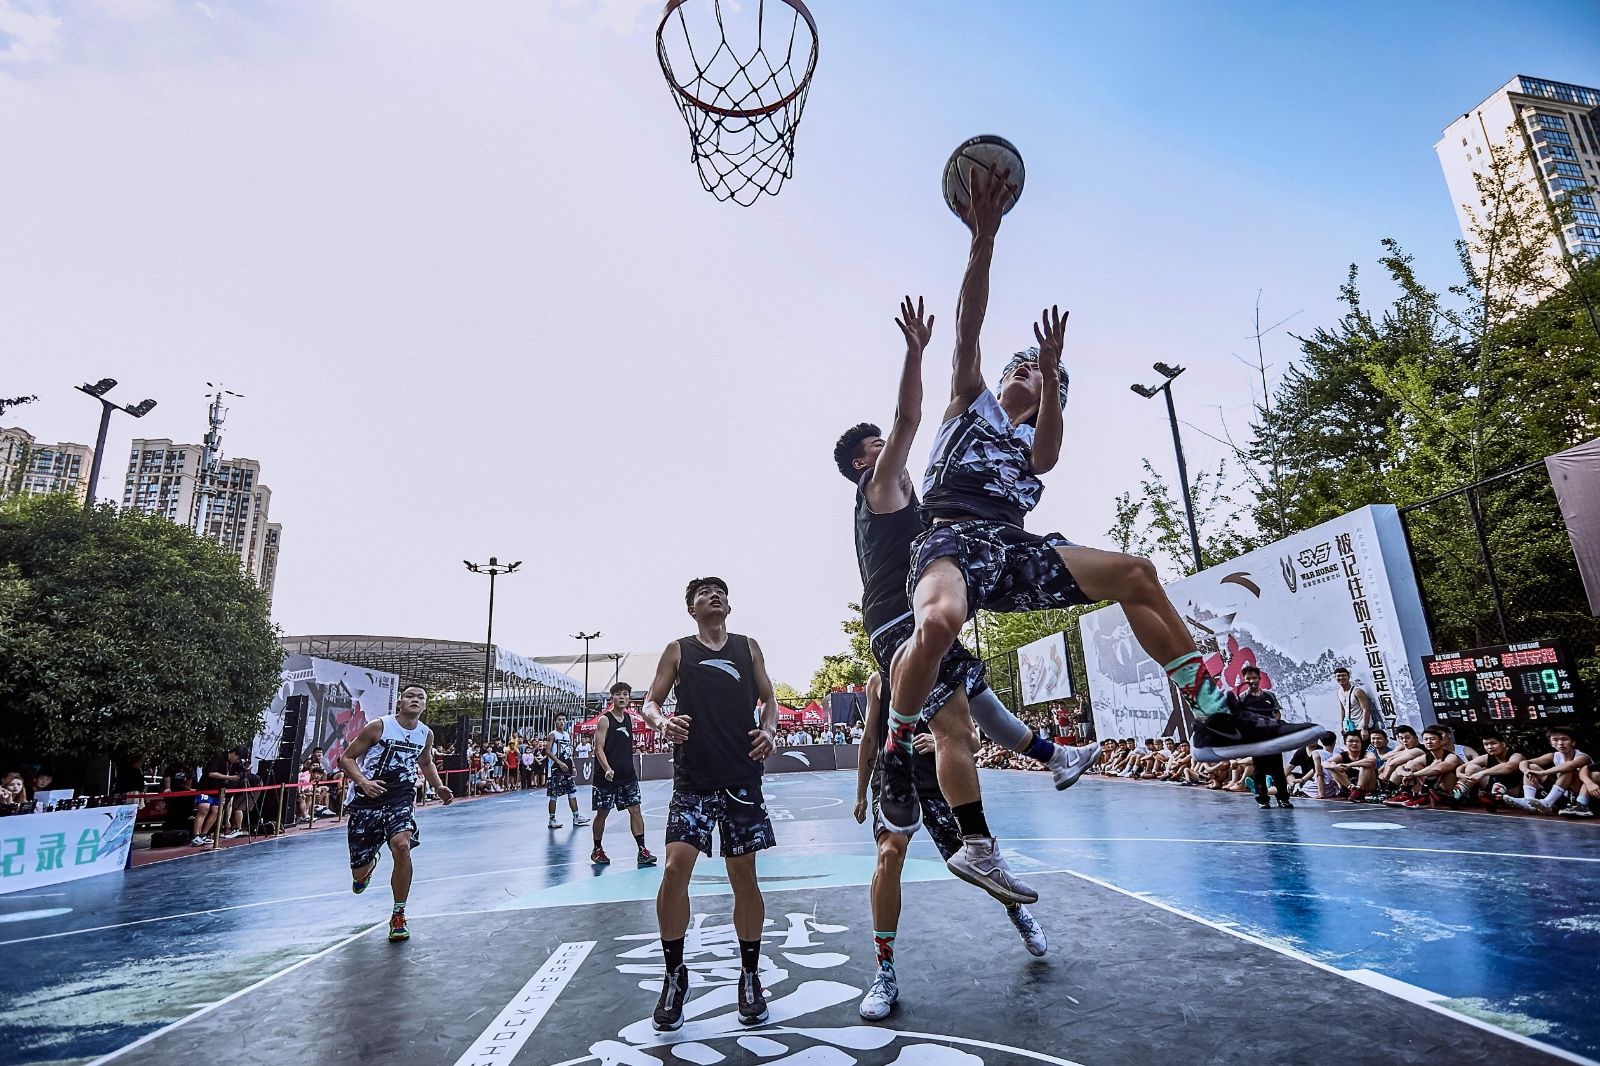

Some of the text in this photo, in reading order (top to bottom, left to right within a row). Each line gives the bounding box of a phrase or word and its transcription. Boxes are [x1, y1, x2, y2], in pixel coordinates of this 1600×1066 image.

[1300, 564, 1339, 581] WAR HORSE
[1450, 678, 1470, 699] 12
[1541, 669, 1559, 693] 9
